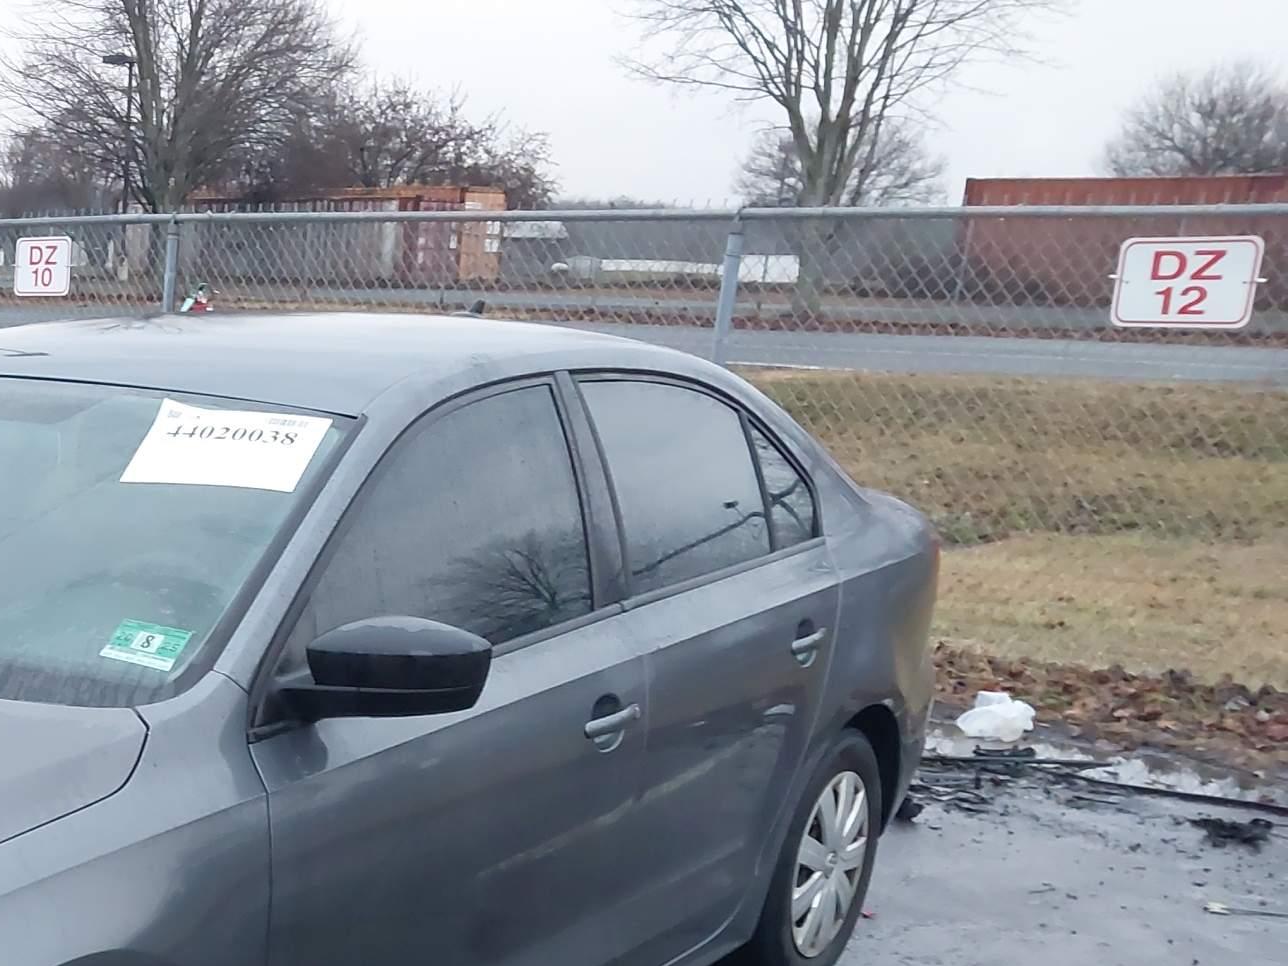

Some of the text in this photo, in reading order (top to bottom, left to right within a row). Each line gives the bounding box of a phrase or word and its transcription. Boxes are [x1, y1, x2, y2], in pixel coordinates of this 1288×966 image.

[29, 245, 58, 265] DZ
[1149, 249, 1228, 281] DZ
[31, 267, 53, 287] 10
[1154, 285, 1209, 316] 12
[166, 423, 299, 446] 44020038
[139, 634, 156, 649] 8
